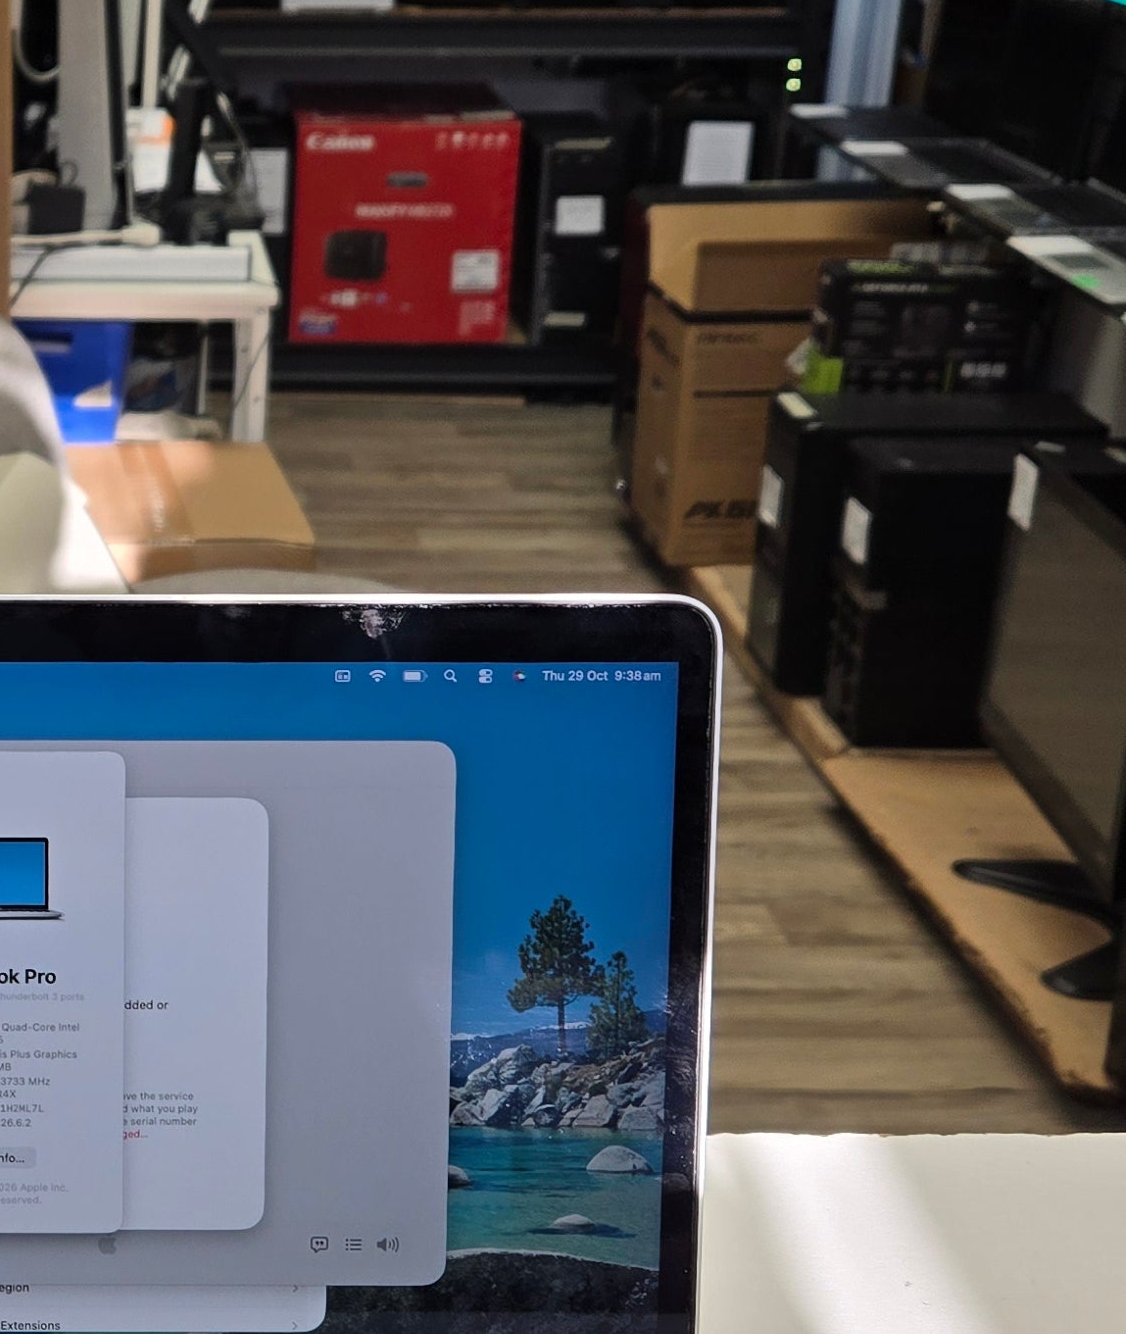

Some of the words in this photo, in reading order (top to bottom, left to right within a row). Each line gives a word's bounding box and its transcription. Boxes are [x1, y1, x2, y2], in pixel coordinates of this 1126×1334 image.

[543, 670, 565, 681] Thu
[568, 670, 584, 681] 29
[587, 670, 608, 681] Oct
[25, 969, 57, 984] Pro
[157, 1002, 169, 1010] or
[1, 1023, 56, 1032] Quad-Core
[59, 1023, 80, 1031] Intel
[10, 1051, 31, 1059] Plus
[33, 1051, 77, 1060] Graphics
[1, 1077, 25, 1086] 3733
[28, 1077, 50, 1086] MHz
[140, 1092, 156, 1100] the
[158, 1092, 194, 1100] service
[132, 1105, 155, 1113] what
[158, 1106, 175, 1114] you
[178, 1105, 198, 1114] play
[1, 1119, 32, 1127] 26.6.2
[131, 1117, 157, 1125] serial
[159, 1117, 197, 1125] number
[0, 1320, 61, 1332] Extensions
